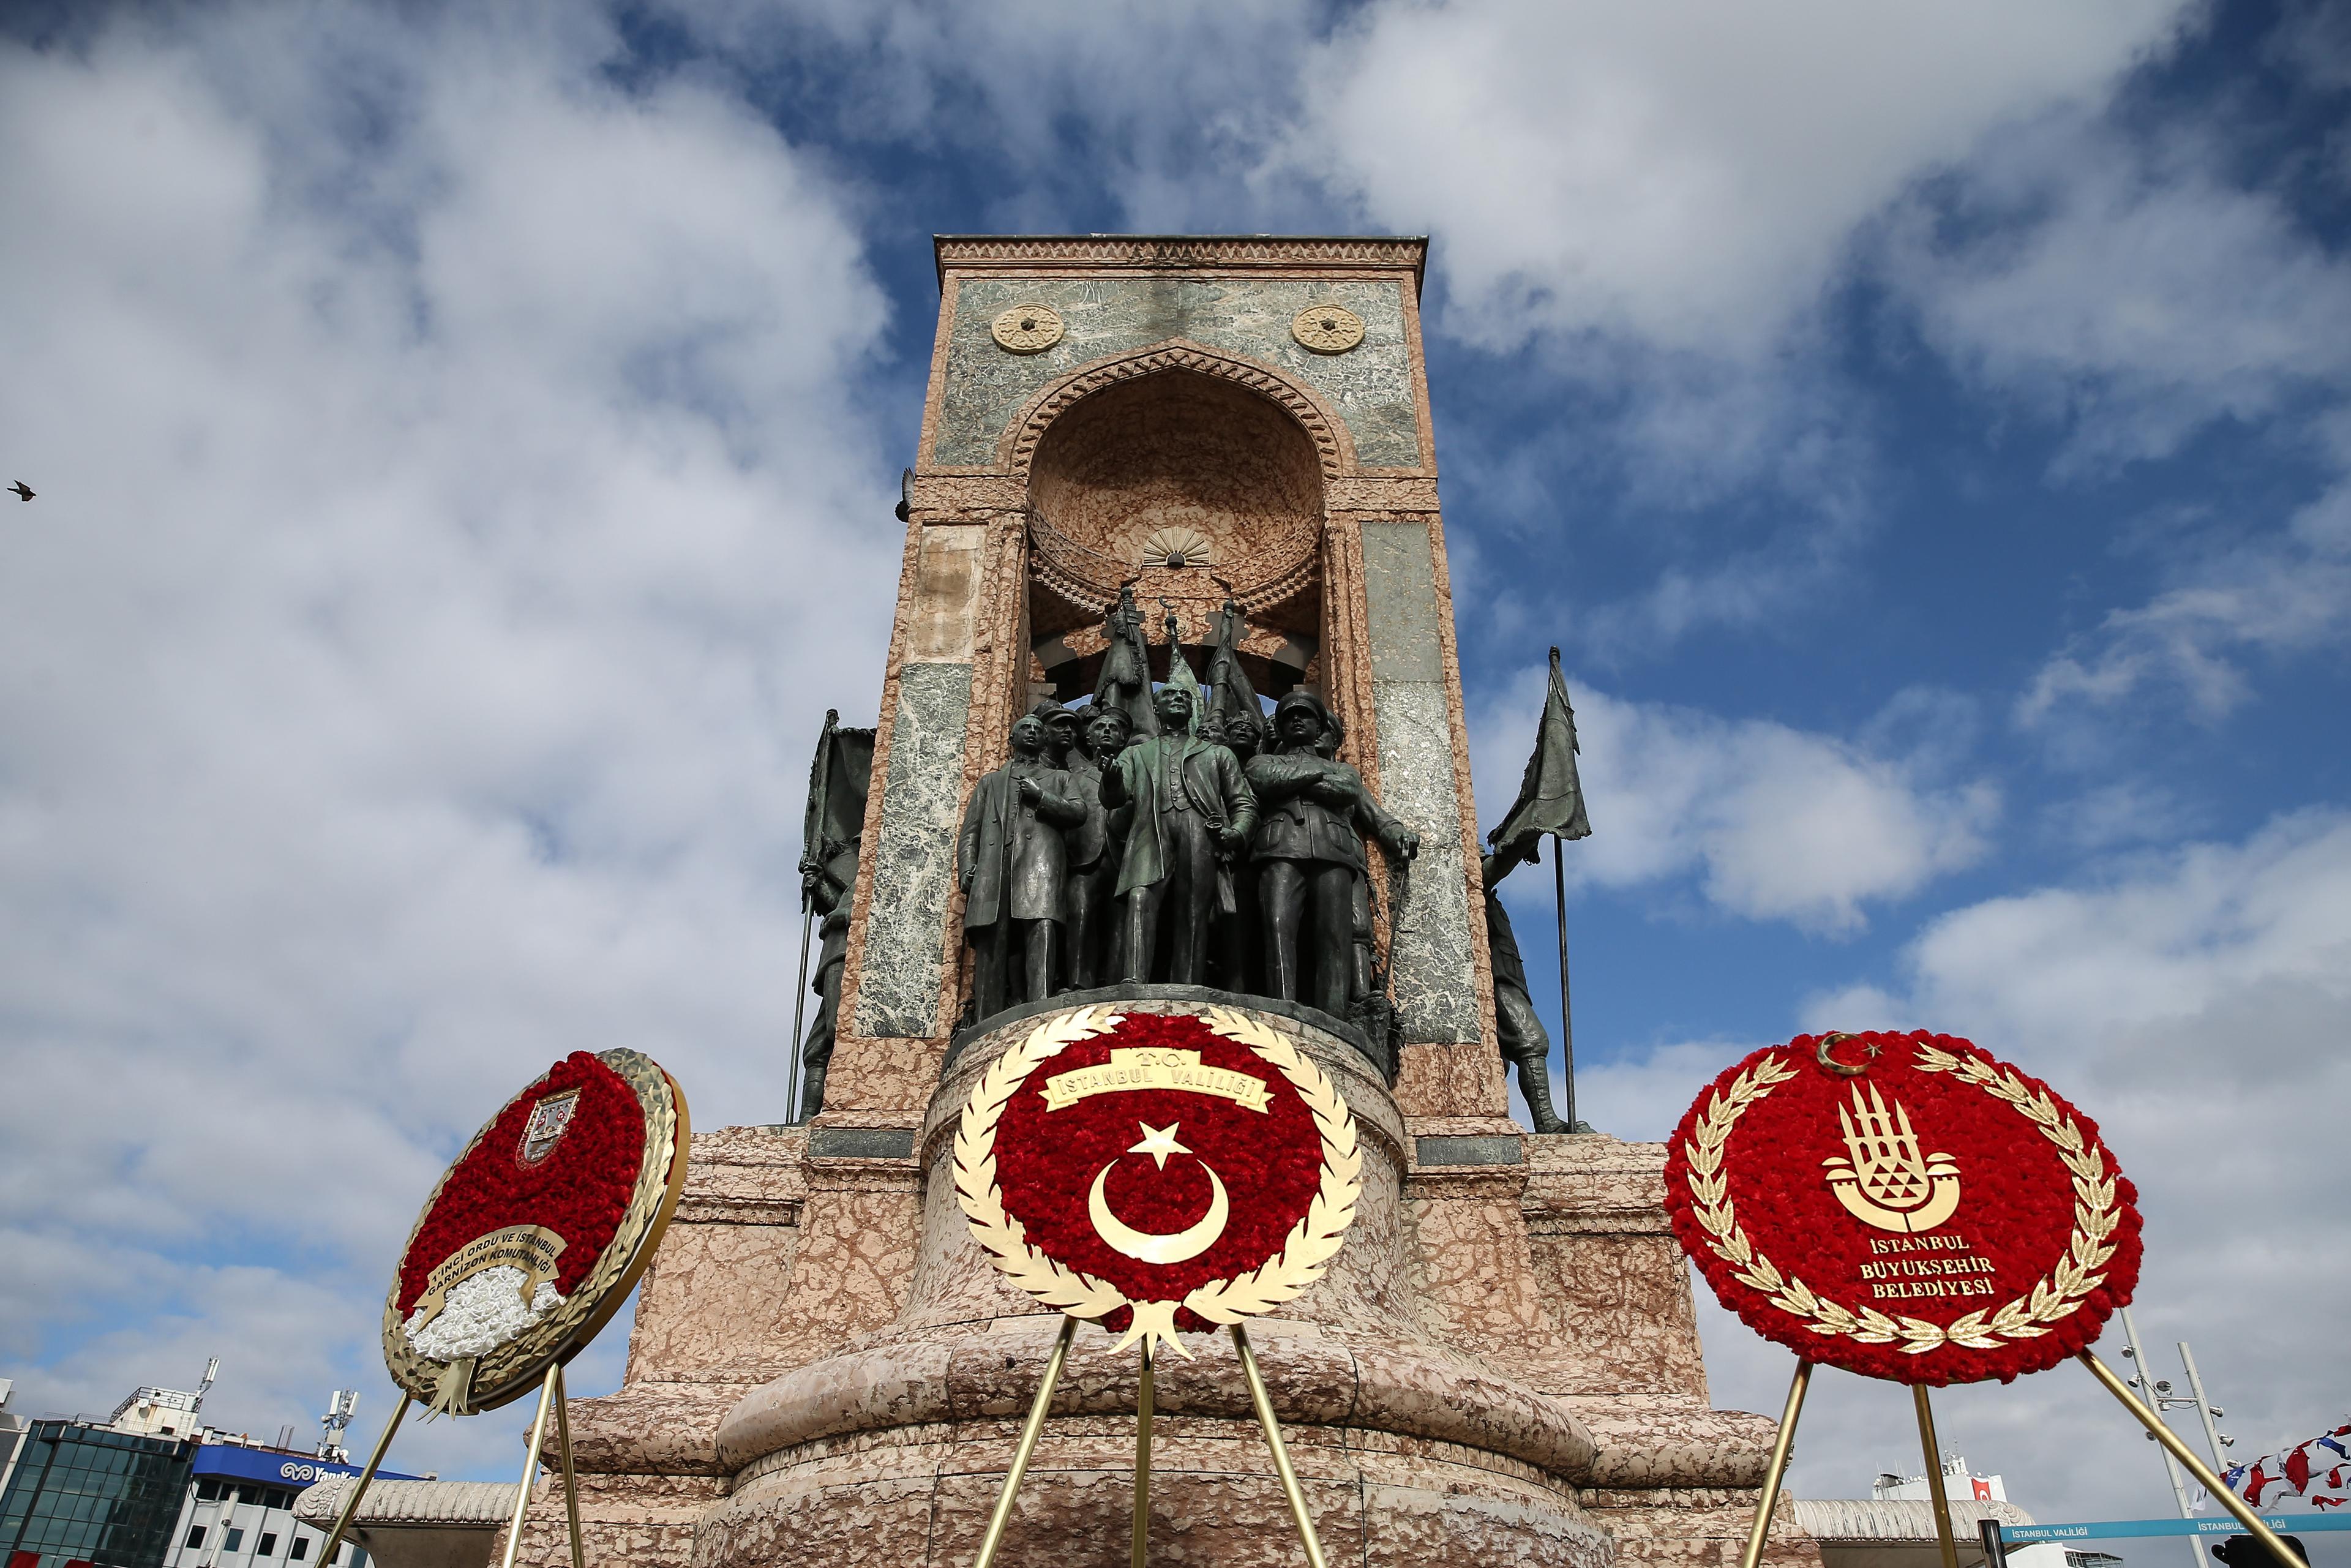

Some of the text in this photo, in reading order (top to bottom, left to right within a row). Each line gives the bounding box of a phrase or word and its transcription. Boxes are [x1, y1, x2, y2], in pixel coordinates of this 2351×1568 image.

[1136, 1051, 1187, 1067] T.C.
[1056, 1068, 1257, 1097] İSTANBUL VALİLİĞİ
[467, 1236, 499, 1257] ORDU
[501, 1232, 517, 1244] VE
[516, 1230, 556, 1258] İSTANBUL
[1870, 1235, 1970, 1255] İSTANBUL
[428, 1248, 551, 1297] GARNİZON KOMUTANLIĞI
[1859, 1256, 1996, 1279] BÜYÜKŞEHİR
[1872, 1277, 1995, 1299] BELEDİYESİ
[2012, 1526, 2088, 1538] İSTANBUL VALİLİĞİ
[2197, 1521, 2245, 1531] İSTANBUL
